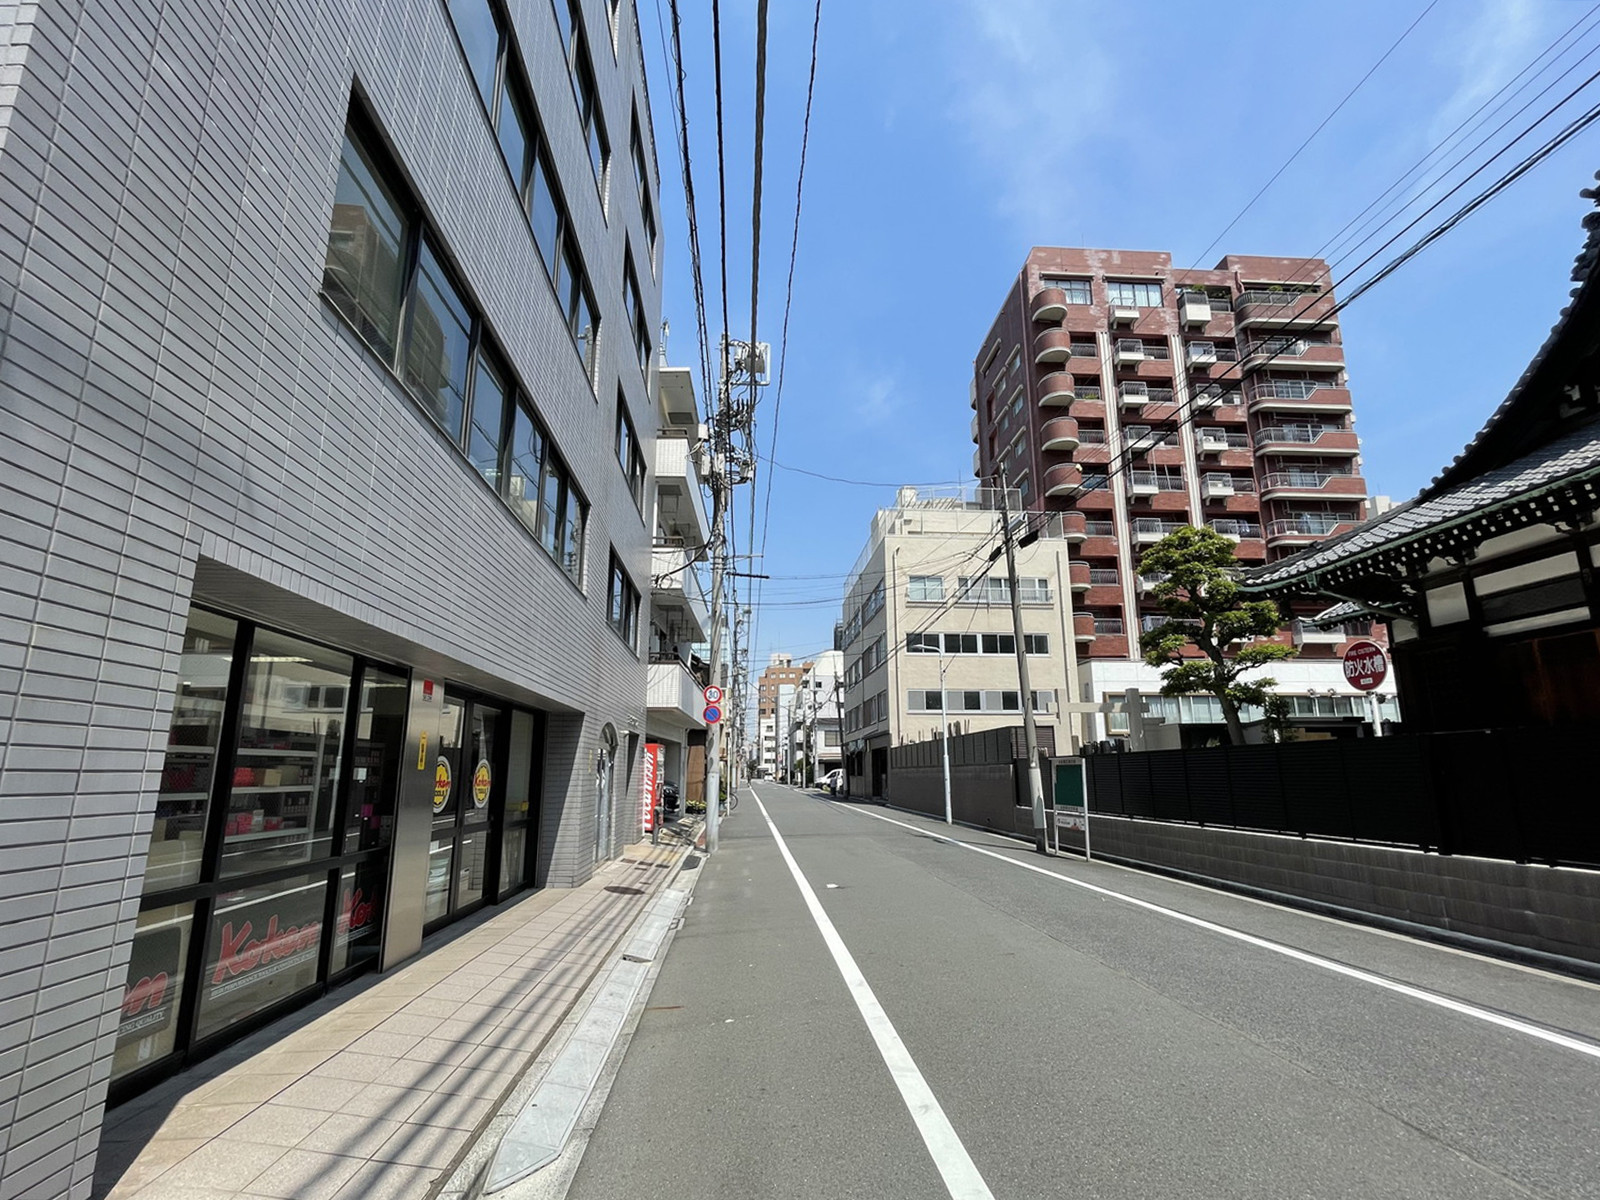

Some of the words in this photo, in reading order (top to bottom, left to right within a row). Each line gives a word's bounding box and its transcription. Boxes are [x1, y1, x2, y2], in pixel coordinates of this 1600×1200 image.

[1344, 654, 1384, 678] 防火水槽
[707, 689, 718, 699] 30
